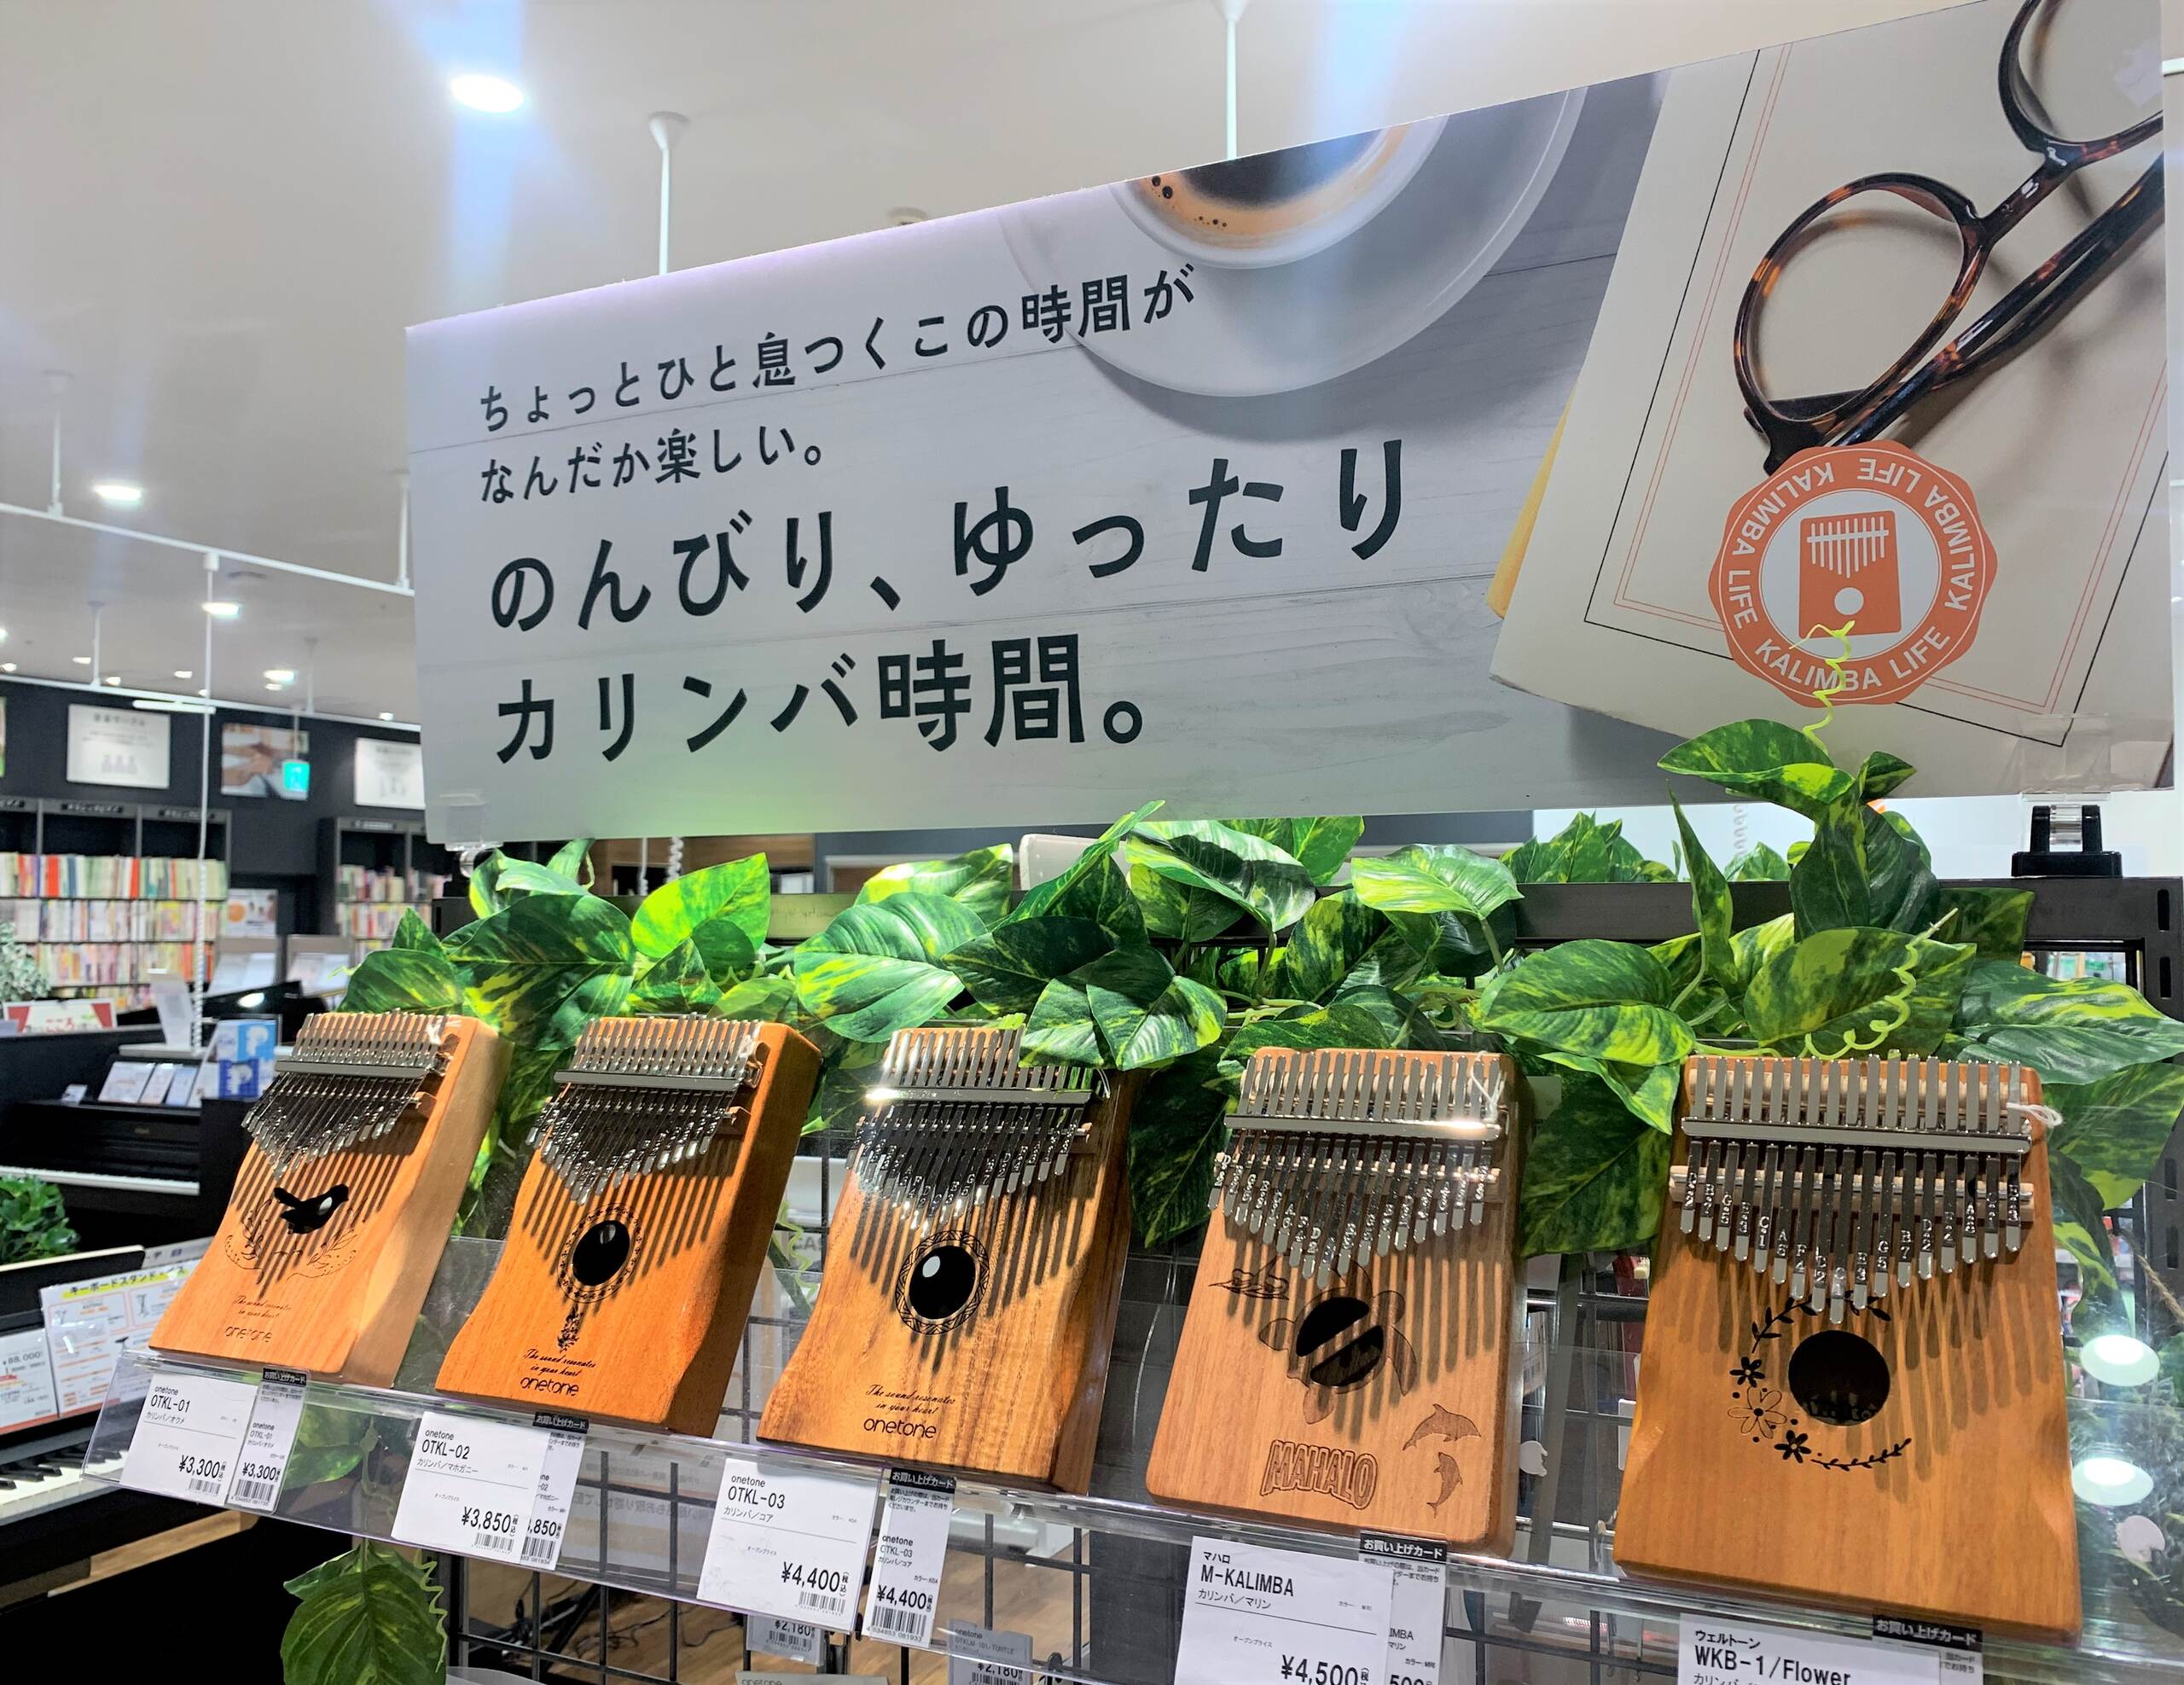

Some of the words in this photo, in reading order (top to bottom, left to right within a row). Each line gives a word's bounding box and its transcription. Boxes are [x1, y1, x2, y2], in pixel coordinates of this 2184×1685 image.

[479, 263, 1196, 430] ちょっとひと息つくこの時間が
[480, 426, 824, 503] なんだか楽しい。
[1856, 457, 1922, 494] LIFE
[1732, 462, 1836, 556] KALIMBA
[490, 440, 1403, 632] のんびり、ゆったり
[1923, 485, 1976, 611] KALIMBA
[1728, 569, 1759, 630] LIFE
[1755, 638, 1883, 692] KALIMBA
[1888, 625, 1951, 681] LIFE
[496, 635, 1143, 764] カリンバ時間。
[154, 1385, 179, 1397] onetone
[520, 1377, 579, 1397] onetone
[150, 1394, 191, 1414] OTKL-01
[249, 1430, 273, 1440] OTKL-01
[253, 1422, 275, 1431] onetone
[425, 1429, 455, 1441] onetone
[863, 1418, 937, 1438] onetone
[421, 1439, 470, 1460] OTKL-02
[178, 1454, 220, 1479] ¥3,300
[241, 1461, 277, 1481] ¥3,300
[1260, 1439, 1378, 1509] MAHALO
[731, 1474, 766, 1488] onetone
[892, 1471, 955, 1489] お買い上げカード
[728, 1485, 785, 1509] OTKL-03
[462, 1506, 512, 1534] ¥3,850
[880, 1545, 913, 1558] OTKL-03
[881, 1535, 914, 1547] onetone
[1364, 1539, 1443, 1559] お買い上げカード
[1203, 1550, 1231, 1565] マハロ
[781, 1561, 840, 1592] ¥4,400
[1200, 1565, 1294, 1597] M-KALIMBA
[876, 1584, 927, 1610] ¥4,400
[1695, 1630, 1761, 1649] ウェルトーン
[1877, 1618, 1977, 1647] お買い上げカード
[1281, 1654, 1359, 1685] ¥4,500
[1694, 1645, 1851, 1685] WKB-1/Flower
